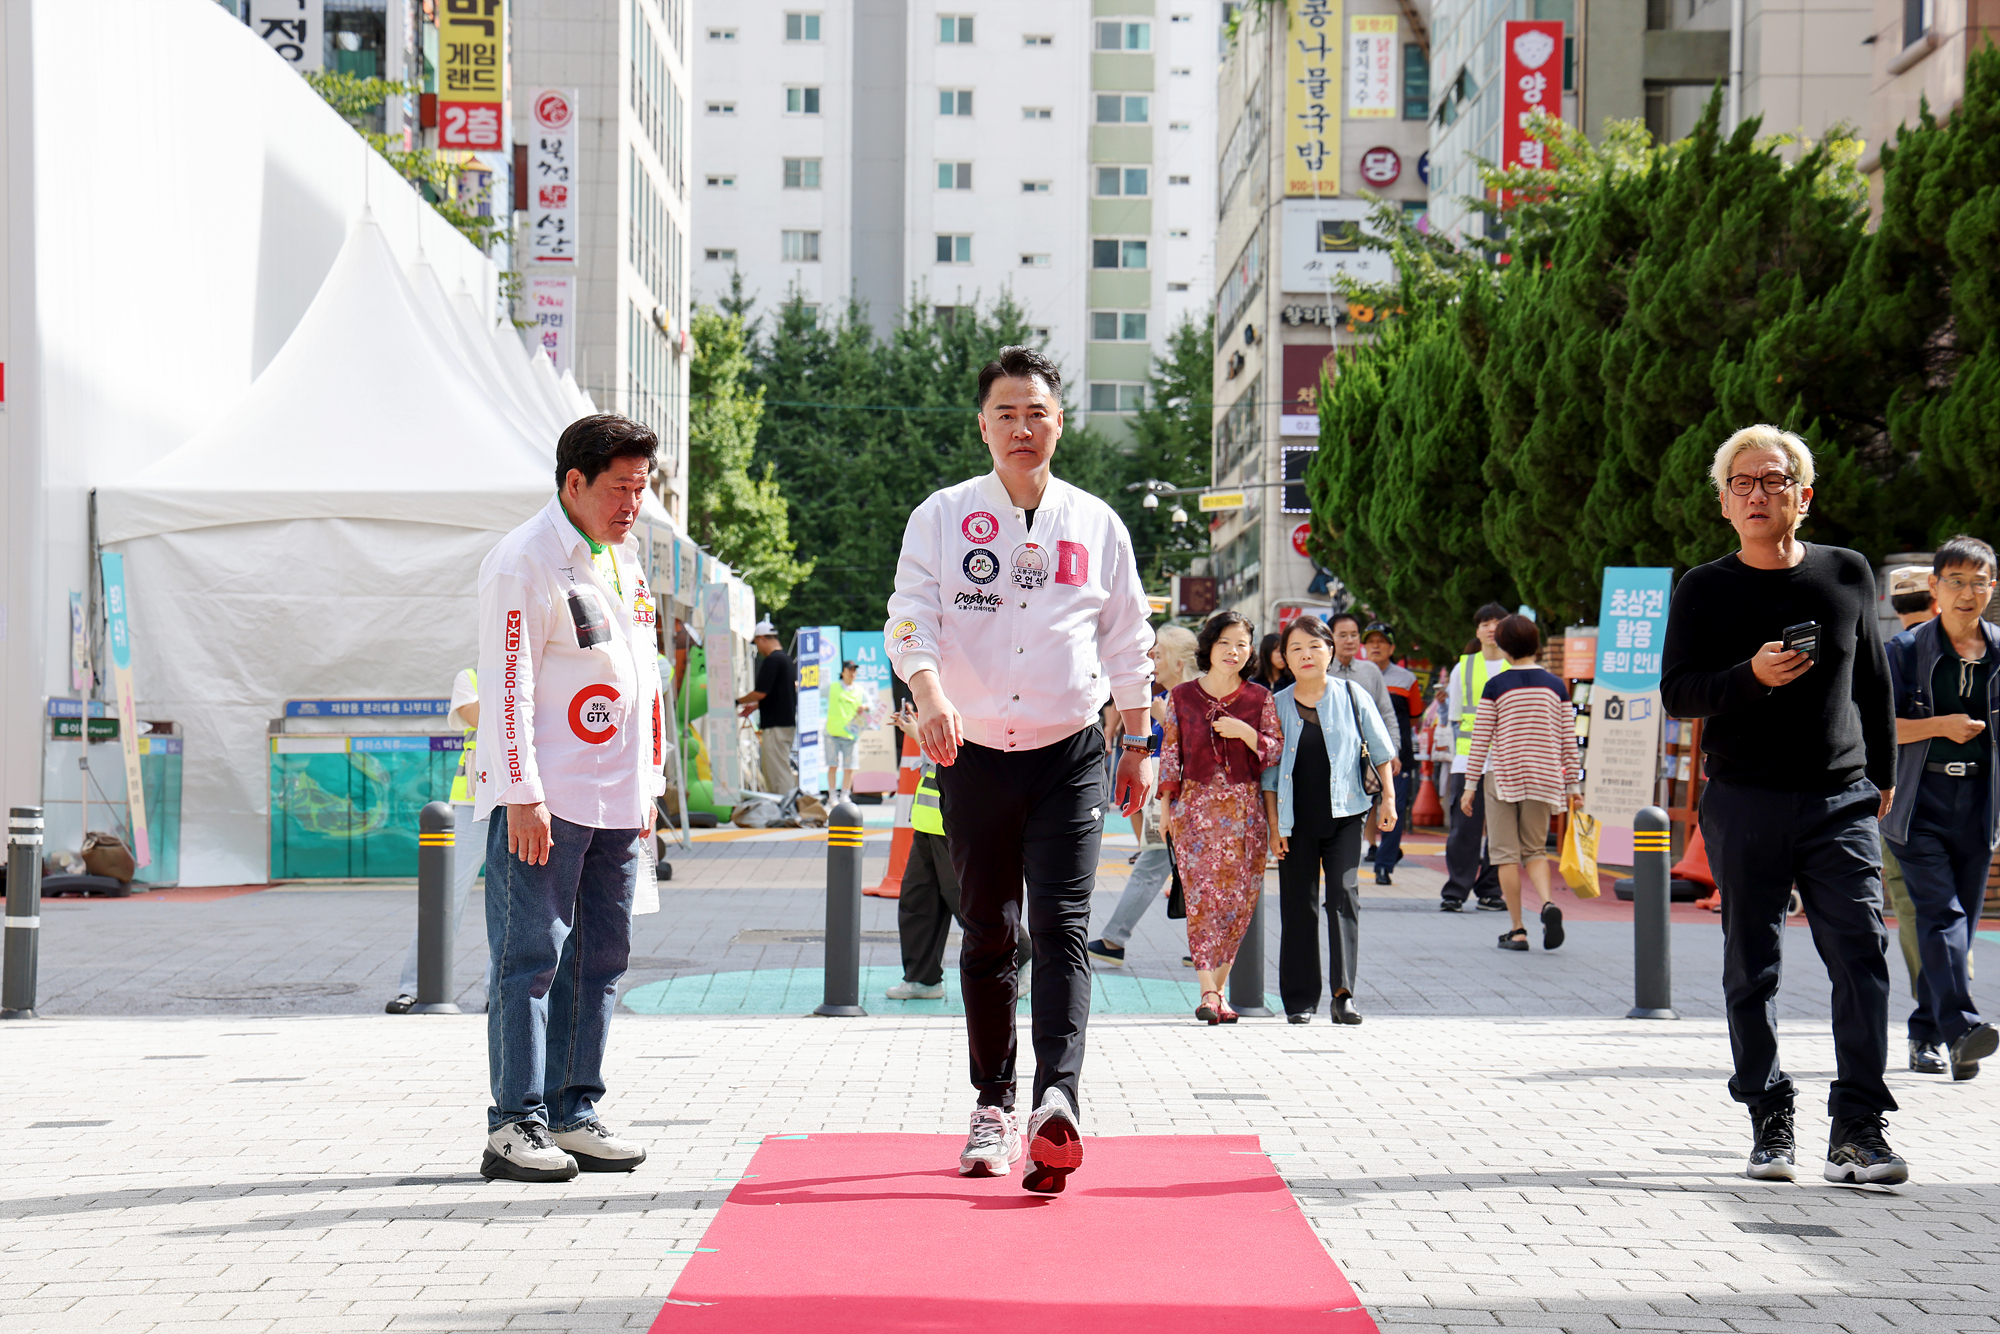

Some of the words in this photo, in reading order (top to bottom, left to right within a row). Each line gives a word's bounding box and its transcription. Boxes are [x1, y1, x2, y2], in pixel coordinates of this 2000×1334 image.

[447, 43, 495, 66] 게임
[447, 68, 496, 91] 랜드
[1297, 0, 1332, 171] 콩나물국밥
[444, 106, 498, 144] 2층
[1366, 153, 1398, 181] 당
[1017, 568, 1043, 577] 도봉구청장
[1055, 540, 1089, 587] D
[954, 591, 1001, 606] DOBONG
[1609, 588, 1664, 618] 초상권
[1616, 619, 1652, 648] 활용
[856, 664, 889, 680] 토부스
[1602, 651, 1630, 673] 동의
[1632, 652, 1660, 674] 안내
[331, 703, 359, 714] 재활용
[362, 703, 400, 714] 분리배출
[403, 702, 432, 713] 나부터
[586, 711, 611, 723] GTX
[591, 703, 607, 711] 창동
